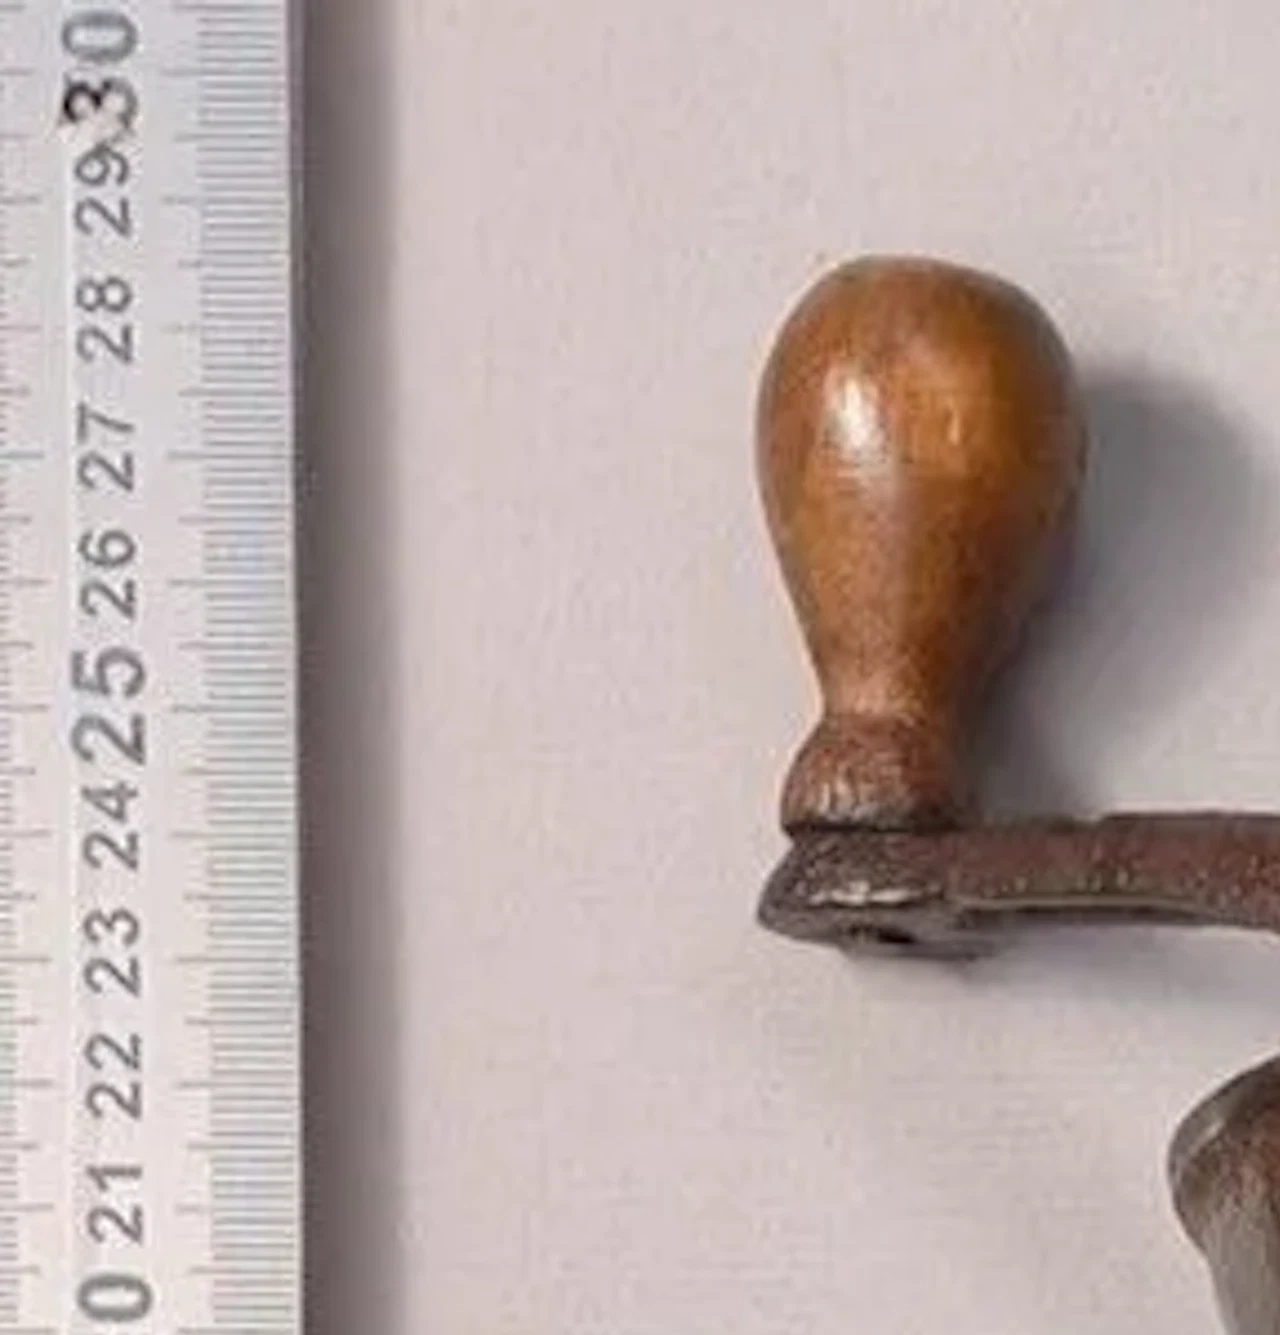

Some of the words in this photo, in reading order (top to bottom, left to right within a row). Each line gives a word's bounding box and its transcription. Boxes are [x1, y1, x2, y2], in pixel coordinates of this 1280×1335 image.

[74, 145, 132, 238] 29
[75, 276, 133, 364] 28
[77, 404, 134, 493] 27
[78, 528, 136, 621] 26
[71, 645, 147, 765] 25
[81, 780, 140, 871] 24
[84, 906, 140, 997] 23
[85, 1032, 141, 1120] 22
[87, 1163, 143, 1244] 21
